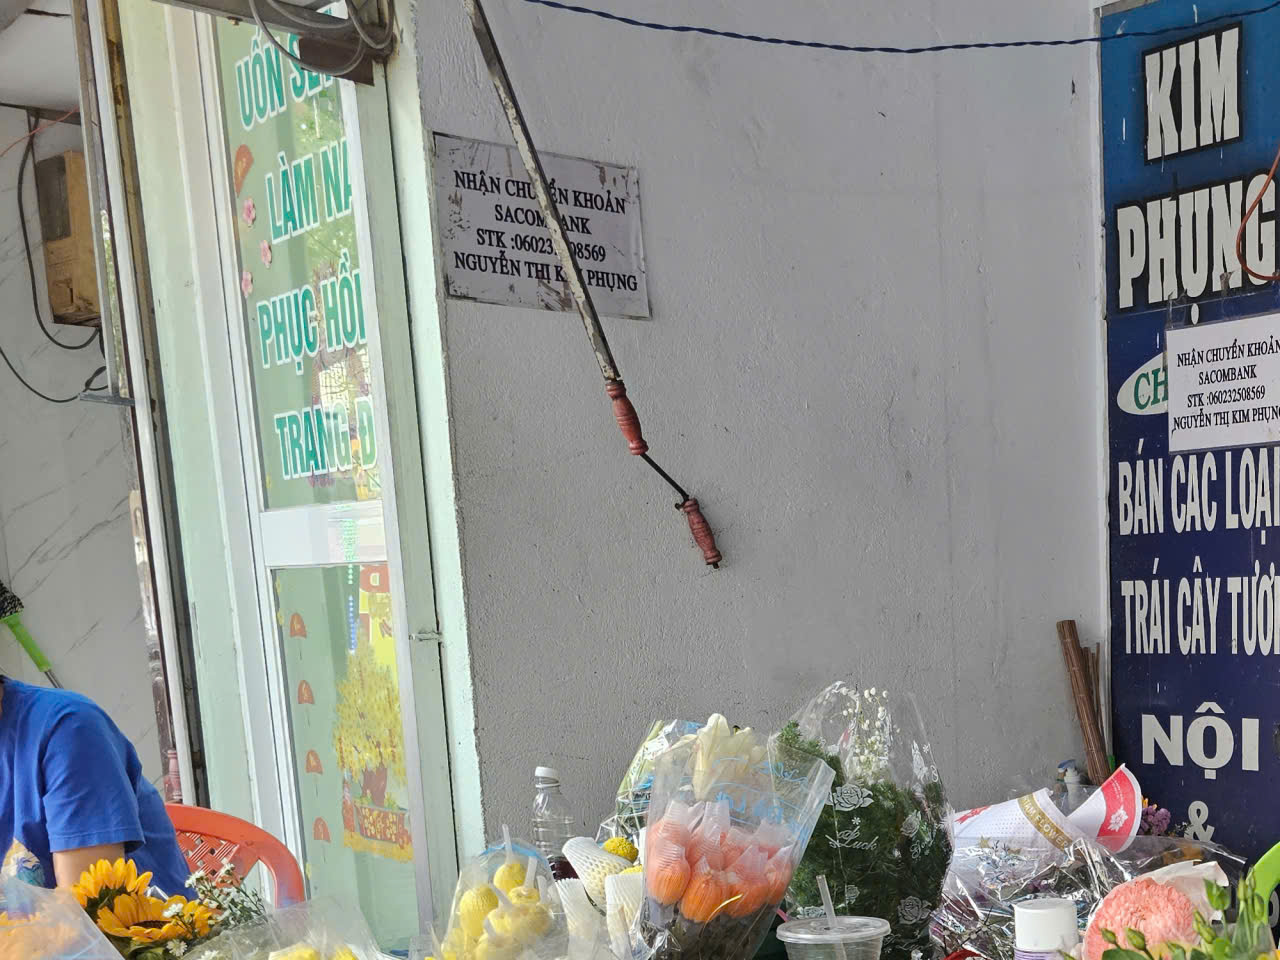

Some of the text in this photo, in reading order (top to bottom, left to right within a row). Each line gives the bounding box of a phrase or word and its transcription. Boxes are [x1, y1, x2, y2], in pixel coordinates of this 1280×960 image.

[235, 28, 286, 130] UỐN
[1145, 27, 1241, 161] KIM
[266, 151, 319, 243] LÀM
[454, 170, 626, 214] NHẬN CHUỂN KHOẢN
[494, 204, 592, 235] SACOMANK
[476, 228, 507, 249] STK
[1116, 174, 1277, 325] PHỤNG
[453, 251, 521, 277] NGUYỄN
[524, 261, 551, 284] THỊ
[587, 269, 638, 292] PHỤNG
[257, 248, 367, 375] PHỤC HỒI
[1177, 348, 1204, 368] NHẬN
[1205, 338, 1245, 363] CHUYỂN
[1199, 364, 1257, 385] SACOMBANK
[1173, 408, 1212, 430] NGUYỄN
[1213, 411, 1230, 427] THỊ
[1232, 409, 1250, 424] KIM
[1187, 393, 1204, 408] STK
[274, 402, 353, 480] TRANG
[1118, 438, 1164, 535] BÁN
[1225, 446, 1280, 545] LOẠI
[1121, 555, 1280, 656] TRÁI CÂY TƯƠI
[1141, 701, 1260, 780] NỘI
[1184, 801, 1215, 841] &
